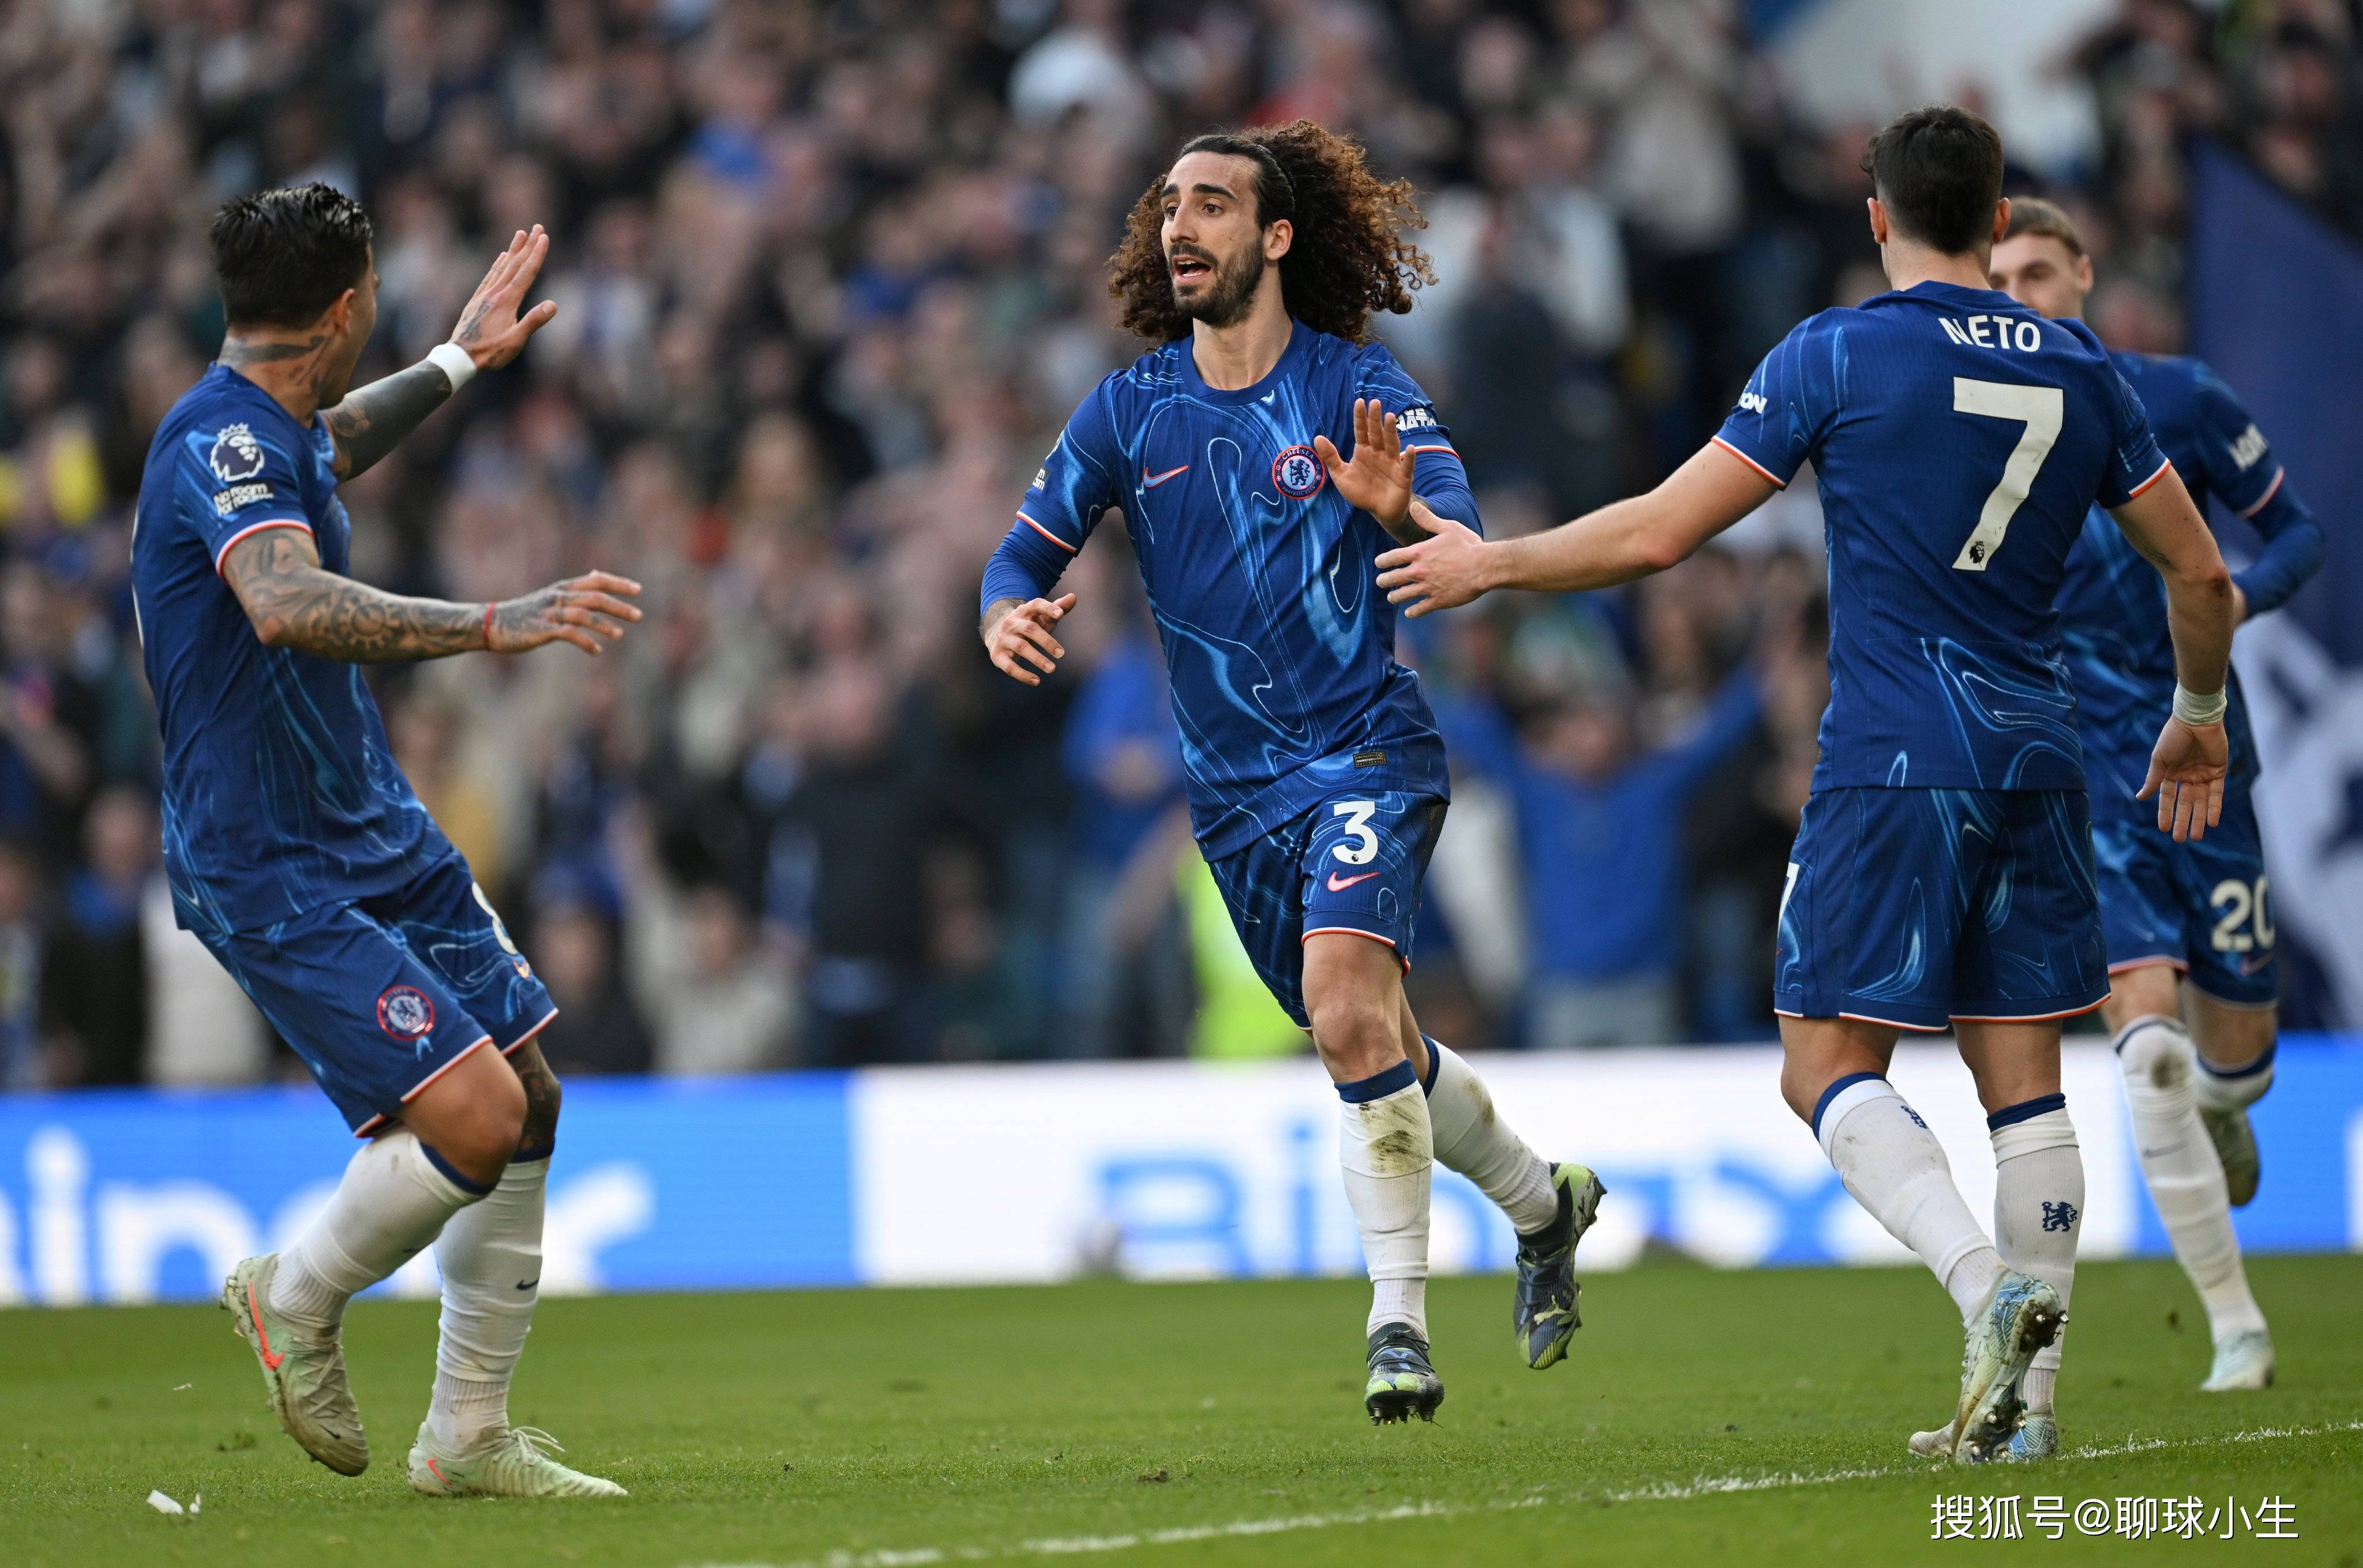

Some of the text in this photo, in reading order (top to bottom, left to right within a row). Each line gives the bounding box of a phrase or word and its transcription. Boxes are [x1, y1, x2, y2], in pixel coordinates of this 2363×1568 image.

[1938, 315, 2041, 352] NETO
[1282, 447, 1314, 460] CHELSEA
[1952, 377, 2064, 571] 7
[1333, 801, 1378, 865] 3
